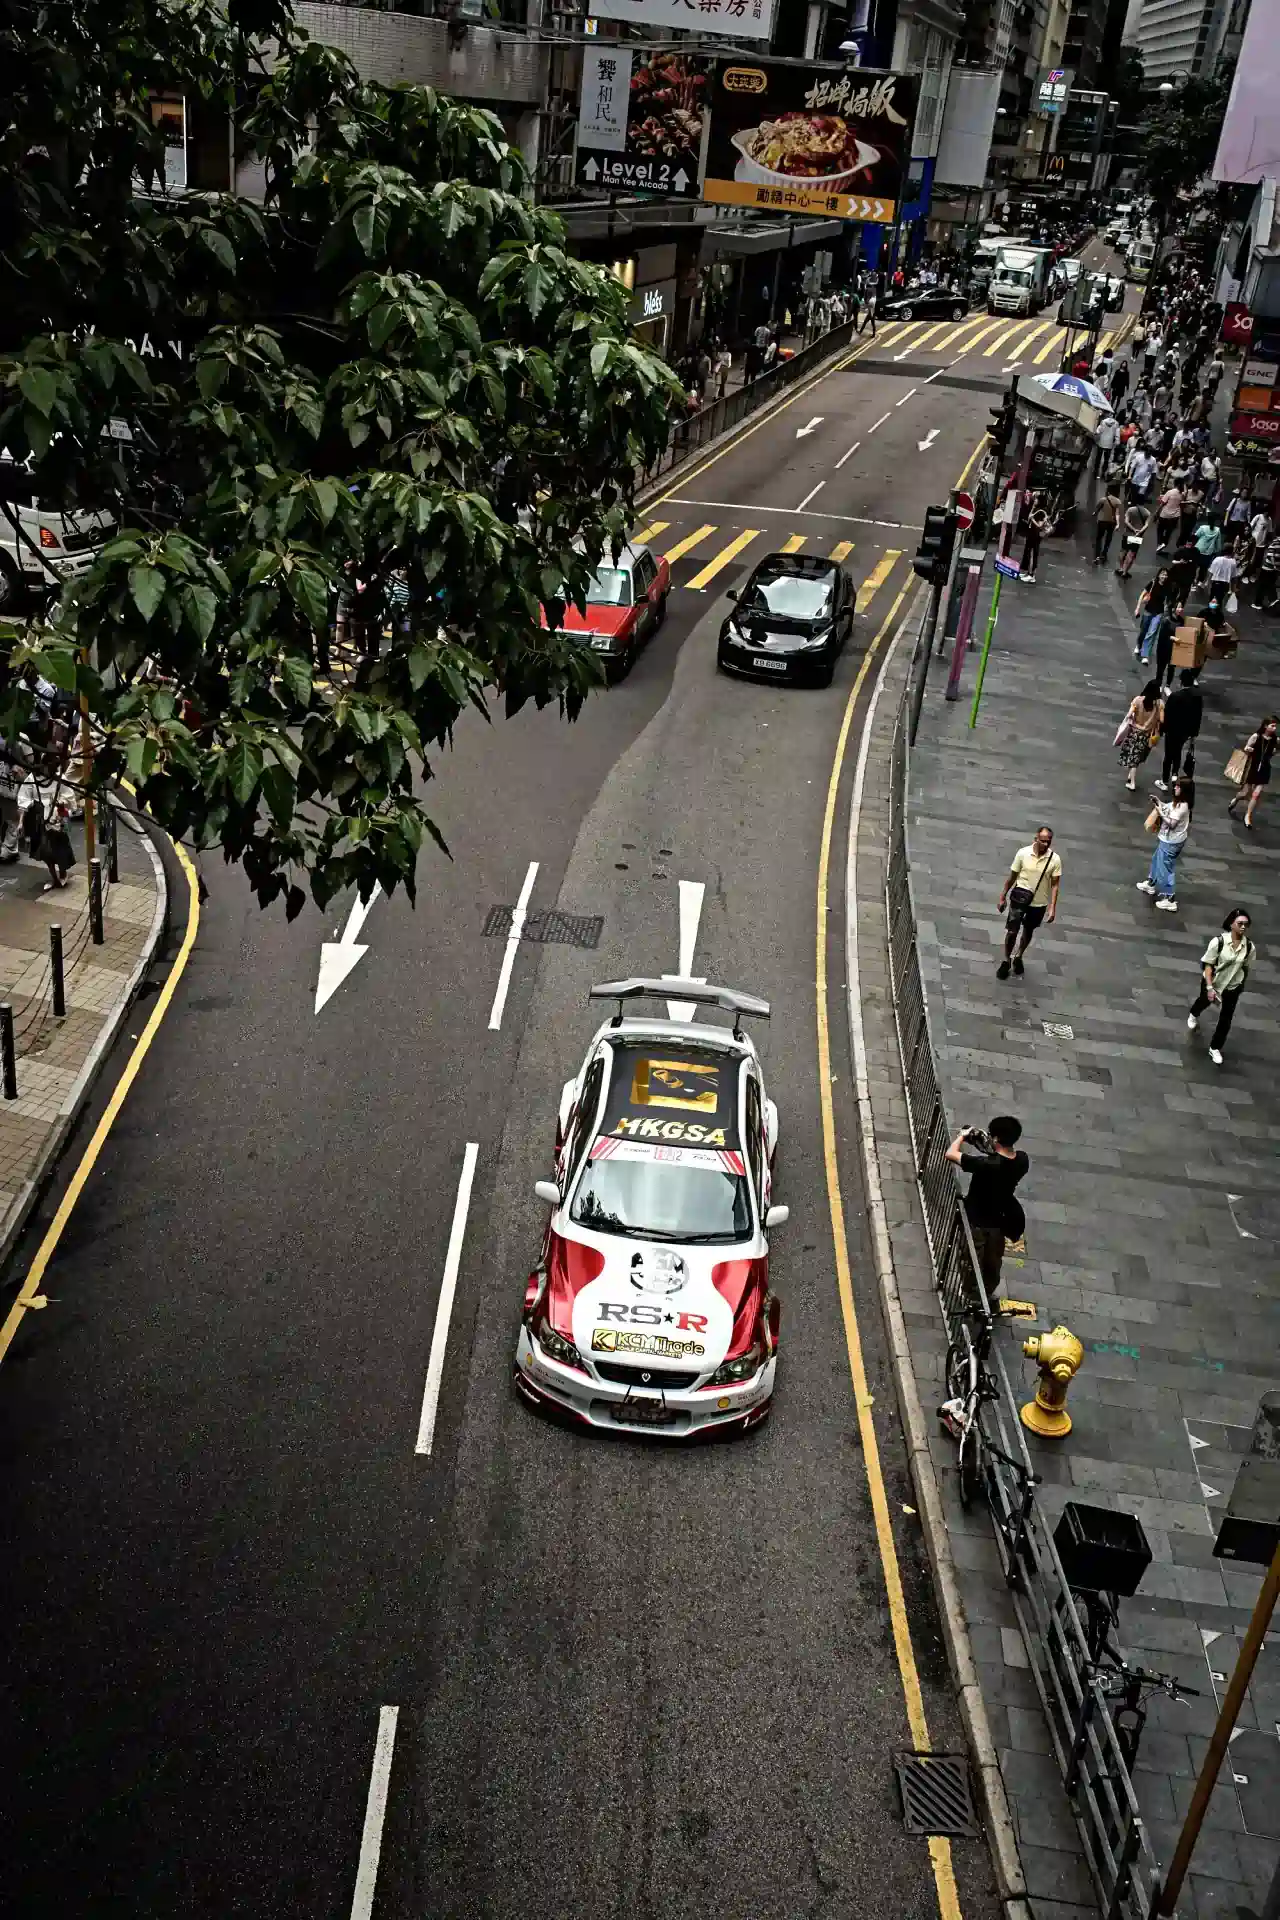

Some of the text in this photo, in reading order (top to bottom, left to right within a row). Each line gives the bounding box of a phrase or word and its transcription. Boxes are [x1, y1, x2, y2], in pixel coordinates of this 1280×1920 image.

[603, 157, 670, 182] Level 2
[602, 175, 668, 190] Man Yee Arcade
[1247, 369, 1274, 378] GNC
[608, 1117, 728, 1146] HKGSA
